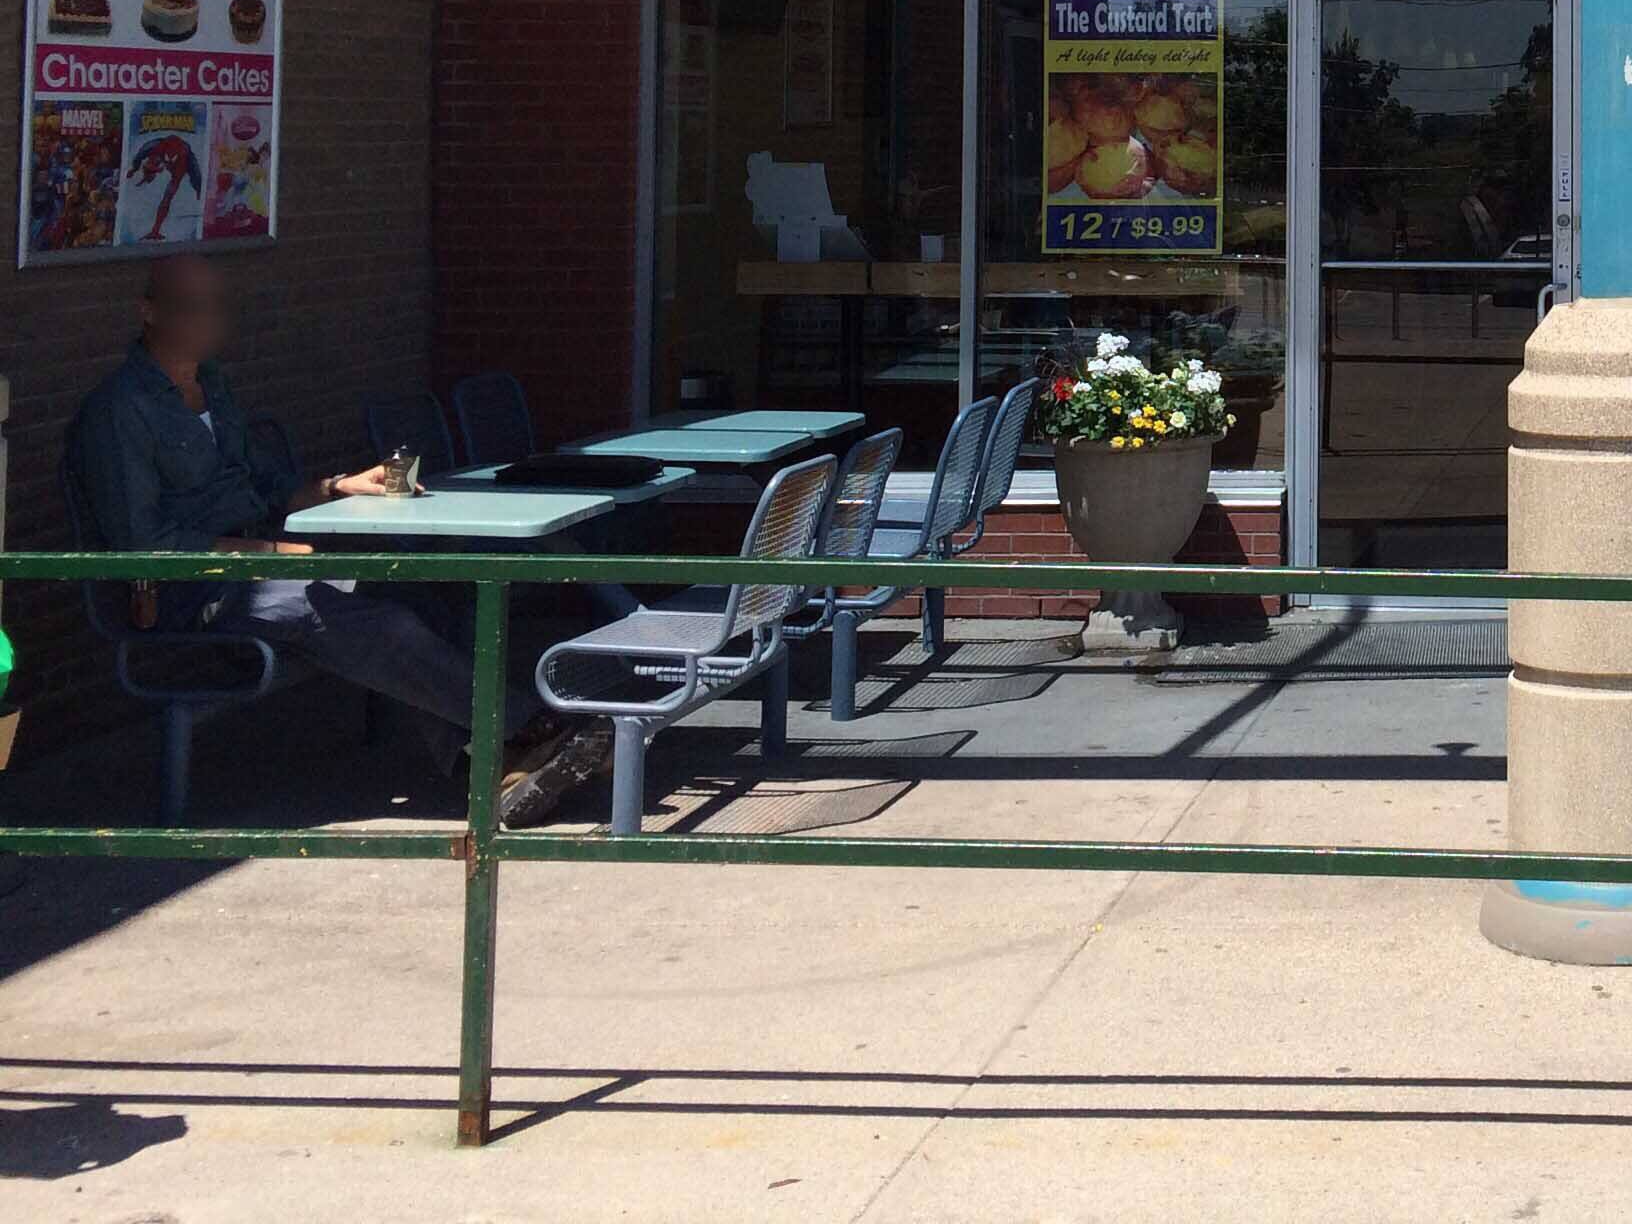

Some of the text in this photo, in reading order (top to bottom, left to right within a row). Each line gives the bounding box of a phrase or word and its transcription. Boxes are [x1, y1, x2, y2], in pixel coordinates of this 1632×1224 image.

[1055, 3, 1213, 33] The Custard Tart
[1055, 47, 1073, 63] A
[1077, 47, 1111, 66] light
[42, 53, 270, 93] Character Cakes
[61, 109, 105, 128] MARVEL
[1059, 211, 1104, 241] 12
[1130, 215, 1206, 240] $9.99
